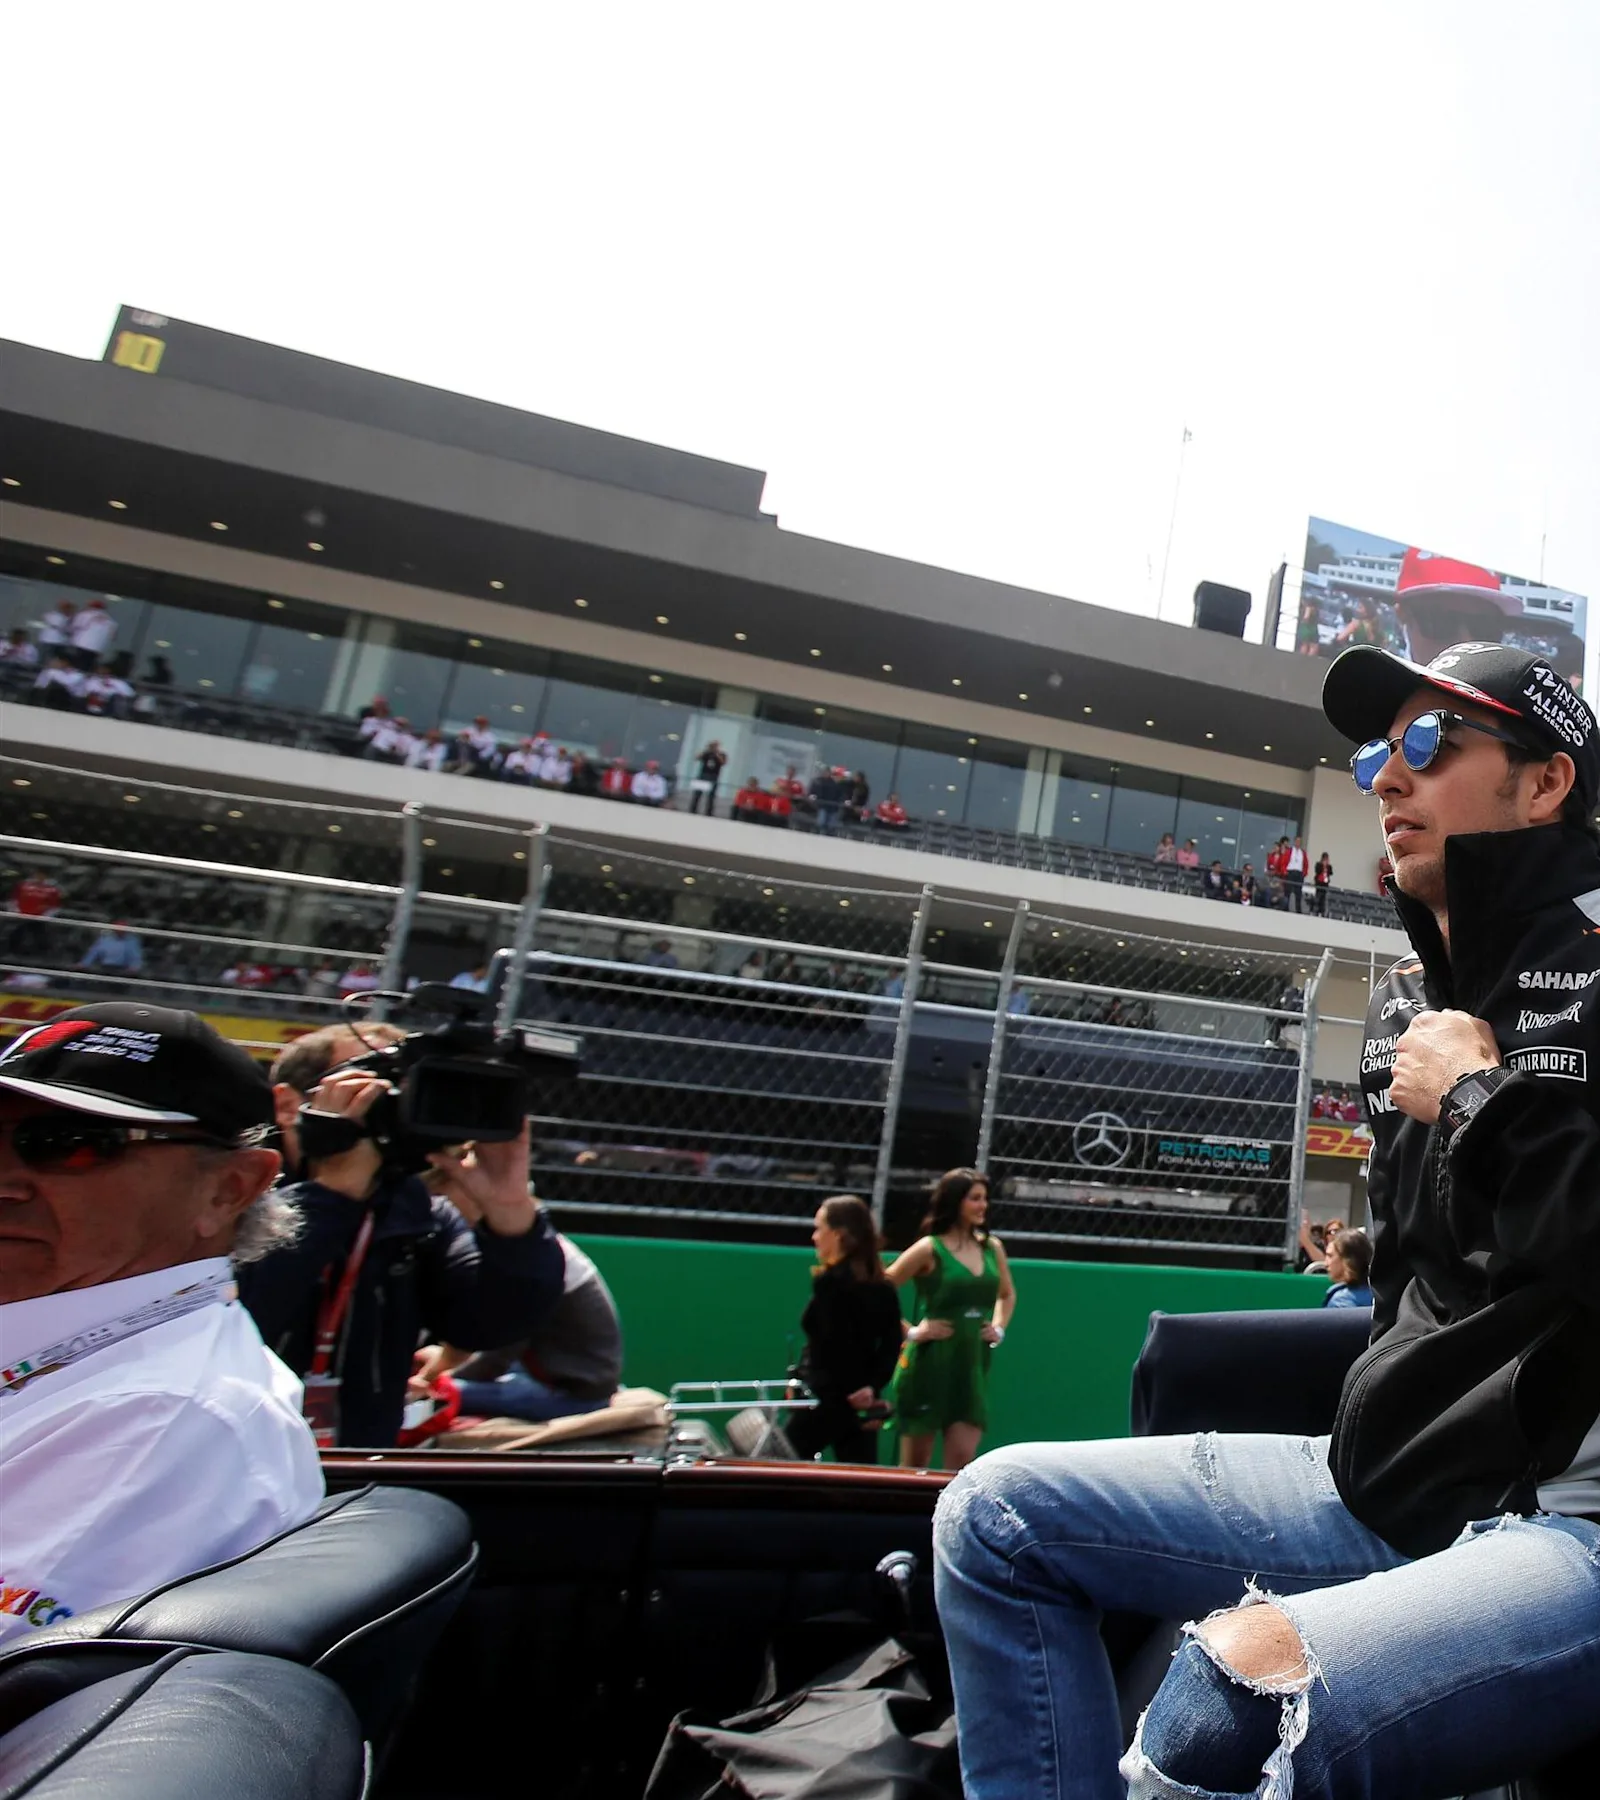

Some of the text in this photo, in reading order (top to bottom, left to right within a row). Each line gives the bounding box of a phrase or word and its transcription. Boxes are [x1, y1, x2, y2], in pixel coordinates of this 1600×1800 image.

[112, 330, 166, 373] 10
[1523, 684, 1584, 747] JALISCO
[1554, 683, 1592, 738] INTER
[1361, 1052, 1397, 1074] CHALLE
[1366, 1088, 1400, 1116] NE
[1158, 1141, 1271, 1164] PETRONAS
[1305, 1127, 1373, 1156] DH
[1157, 1155, 1211, 1167] FORMULA
